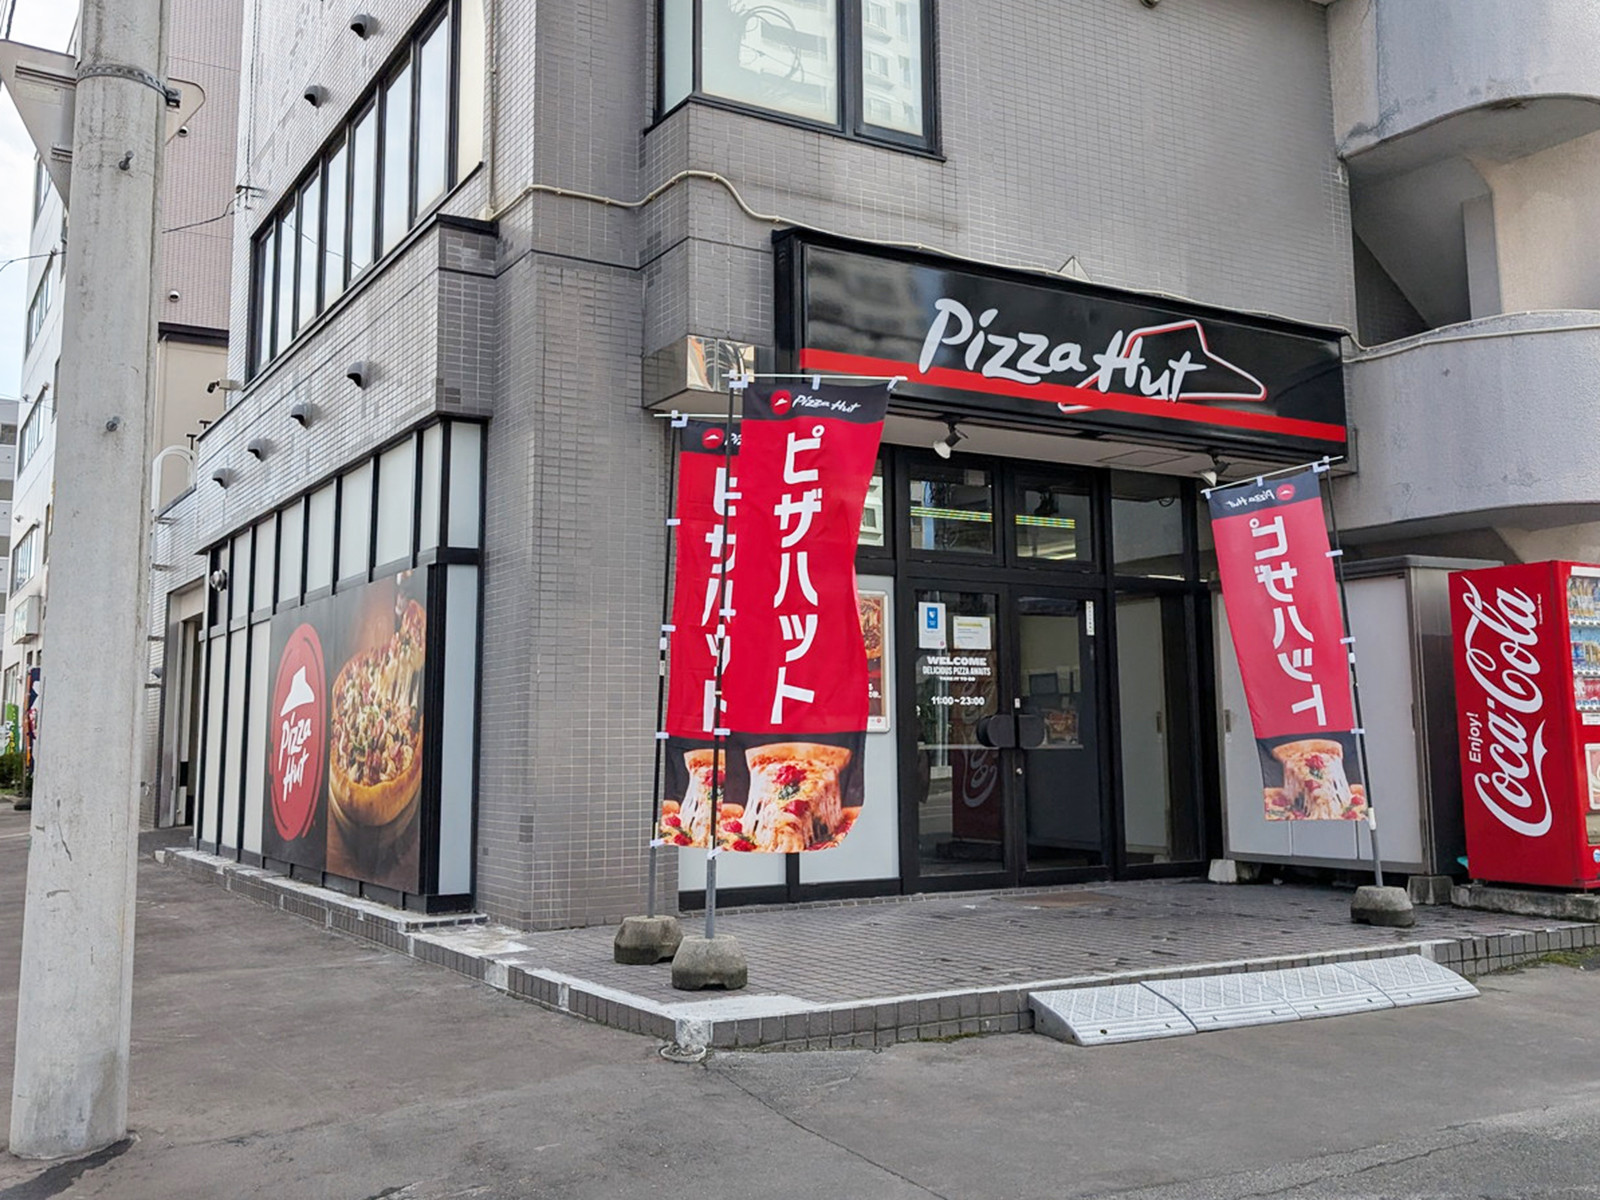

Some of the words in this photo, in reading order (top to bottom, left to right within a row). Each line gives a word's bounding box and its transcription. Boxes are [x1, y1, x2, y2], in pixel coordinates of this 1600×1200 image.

[919, 299, 1087, 383] Pizza
[1093, 330, 1206, 402] Hut
[792, 394, 830, 408] Pizza
[830, 400, 861, 413] Hut
[770, 424, 825, 724] ピザハット
[922, 666, 953, 675] DELICIOUS
[953, 666, 969, 676] PIZZA
[926, 655, 987, 666] WELCOME
[1461, 576, 1552, 837] Coca-Cola
[279, 711, 312, 772] Pizza
[1466, 712, 1483, 763] Enjoy!
[283, 748, 310, 802] Hut
